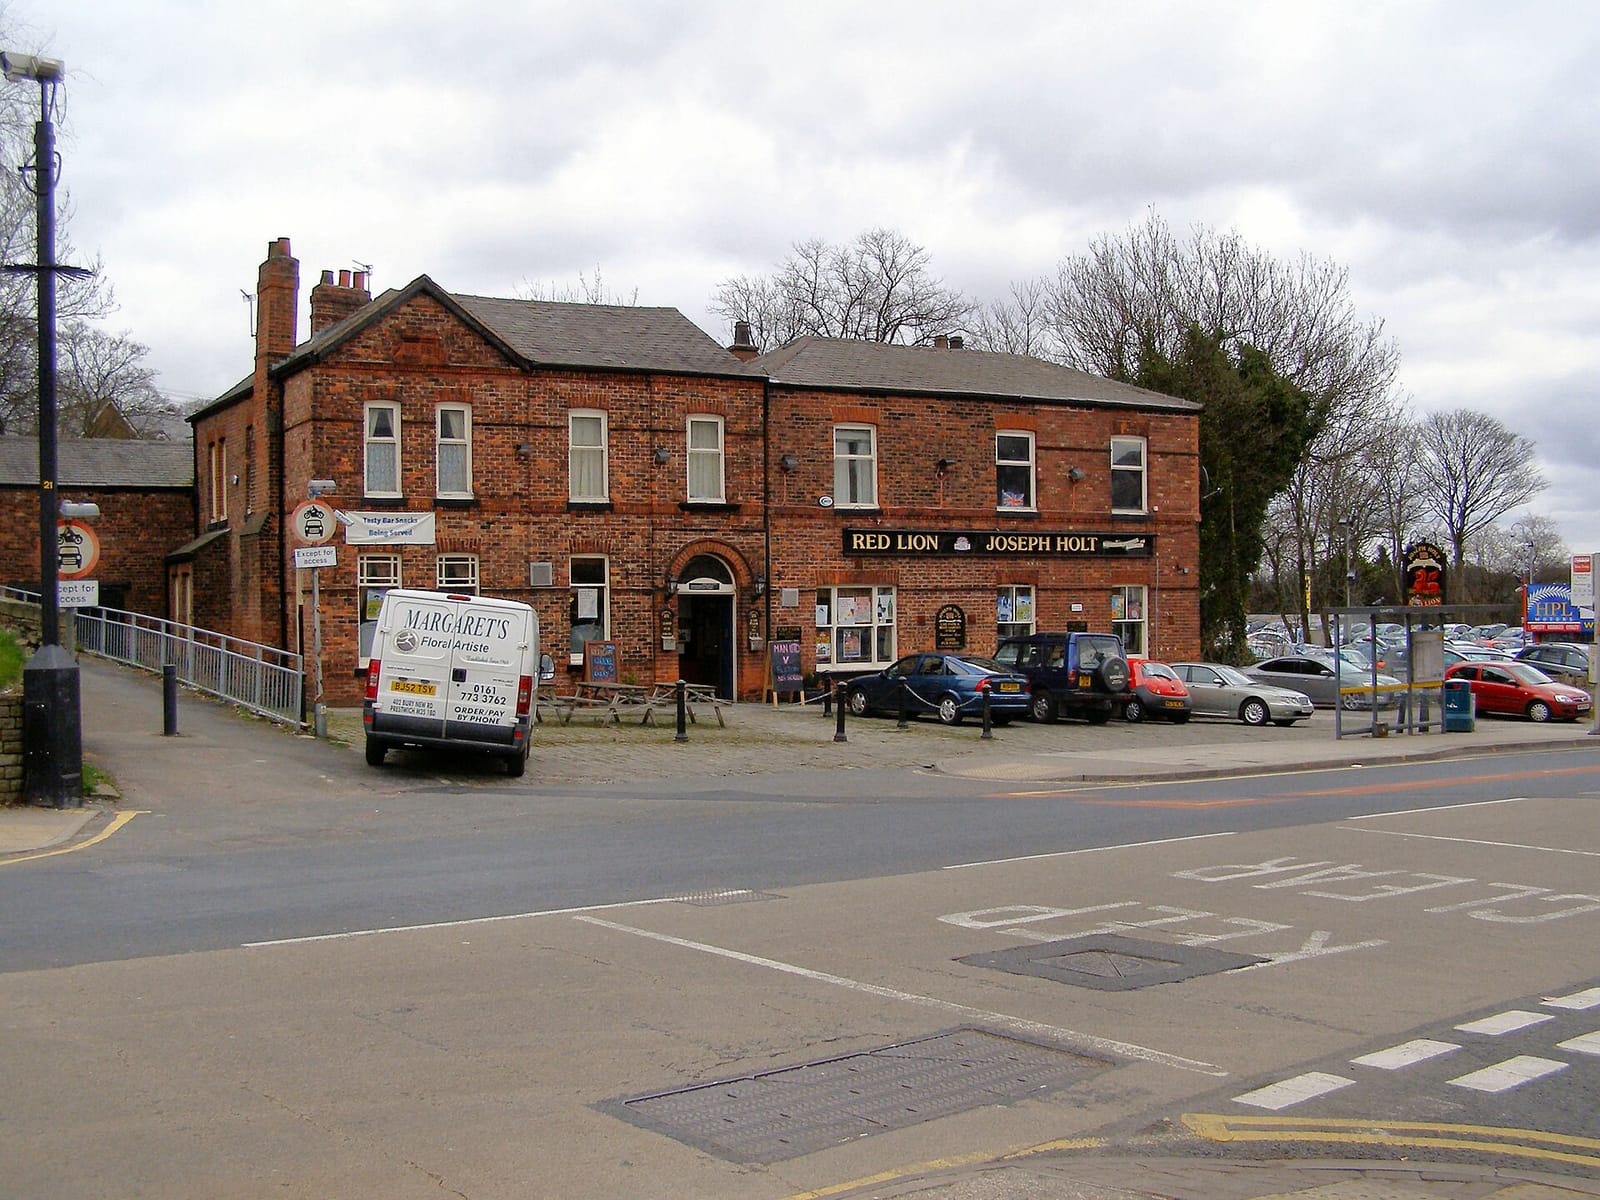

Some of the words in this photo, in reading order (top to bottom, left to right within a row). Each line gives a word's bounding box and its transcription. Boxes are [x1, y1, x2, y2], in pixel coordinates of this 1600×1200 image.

[43, 481, 53, 489] 21
[363, 517, 381, 525] Tasty
[396, 516, 417, 524] Snacks
[368, 529, 388, 537] Being
[852, 533, 891, 550] RED
[897, 534, 939, 551] LION
[986, 535, 1050, 552] JOSEPH
[1056, 536, 1098, 552] HOLT
[297, 549, 321, 559] Except
[1407, 545, 1427, 560] JOSEPH
[1427, 546, 1441, 559] HOLT
[58, 585, 78, 597] cept
[82, 584, 95, 592] for
[1535, 601, 1573, 617] HPL
[404, 609, 510, 640] MARGARET'S
[421, 636, 452, 649] Floral
[453, 640, 489, 653] Artiste
[773, 643, 789, 653] MAN
[782, 656, 790, 665] V
[394, 681, 416, 693] BJ52
[418, 683, 434, 694] TSY
[473, 684, 496, 695] 0161
[460, 692, 479, 702] 773
[482, 694, 507, 706] 3762
[454, 706, 505, 717] ORDER/PAY
[457, 713, 469, 722] BY
[470, 714, 500, 725] PHONE
